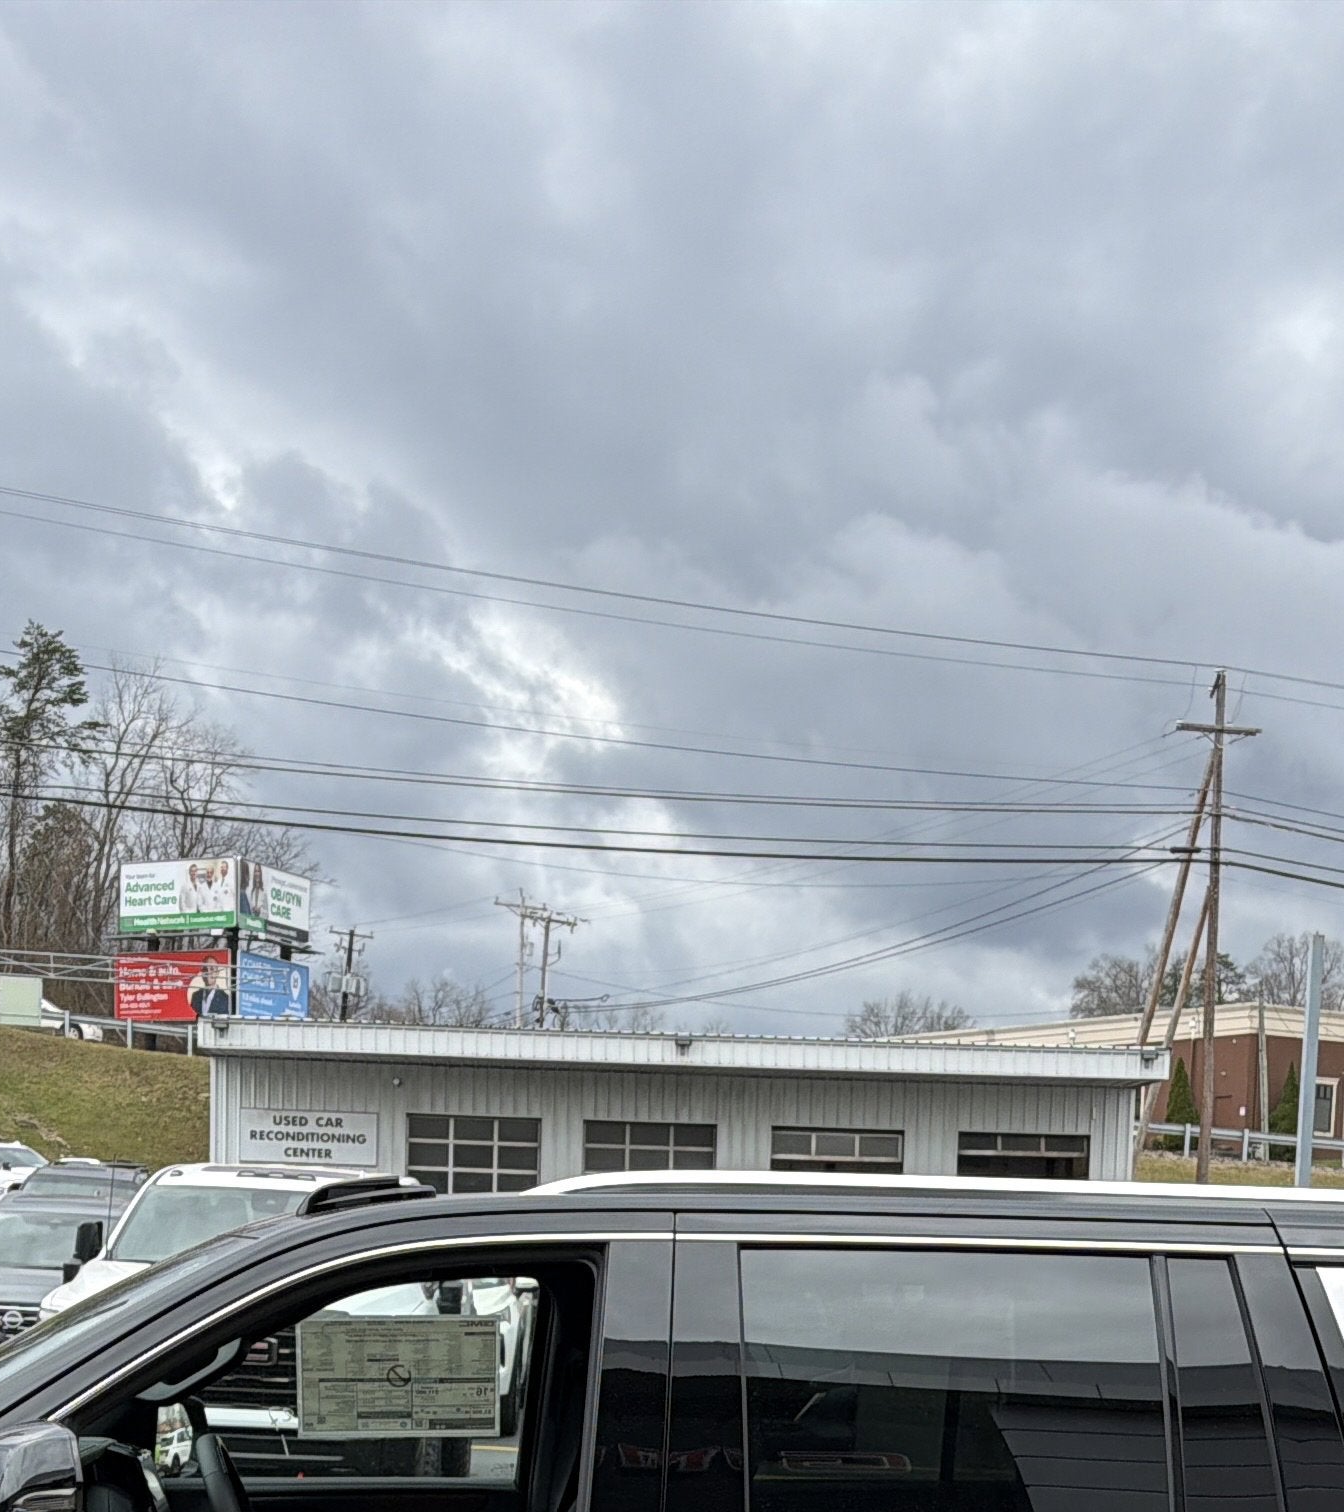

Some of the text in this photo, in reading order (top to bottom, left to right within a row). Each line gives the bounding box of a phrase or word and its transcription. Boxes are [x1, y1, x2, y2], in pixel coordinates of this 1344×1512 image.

[125, 880, 175, 893] Advanced
[125, 895, 177, 907] Heart Care
[271, 903, 292, 920] CARE
[273, 1115, 343, 1128] USED CAR
[250, 1130, 367, 1144] RECONDITIONING
[284, 1147, 332, 1159] CENTER
